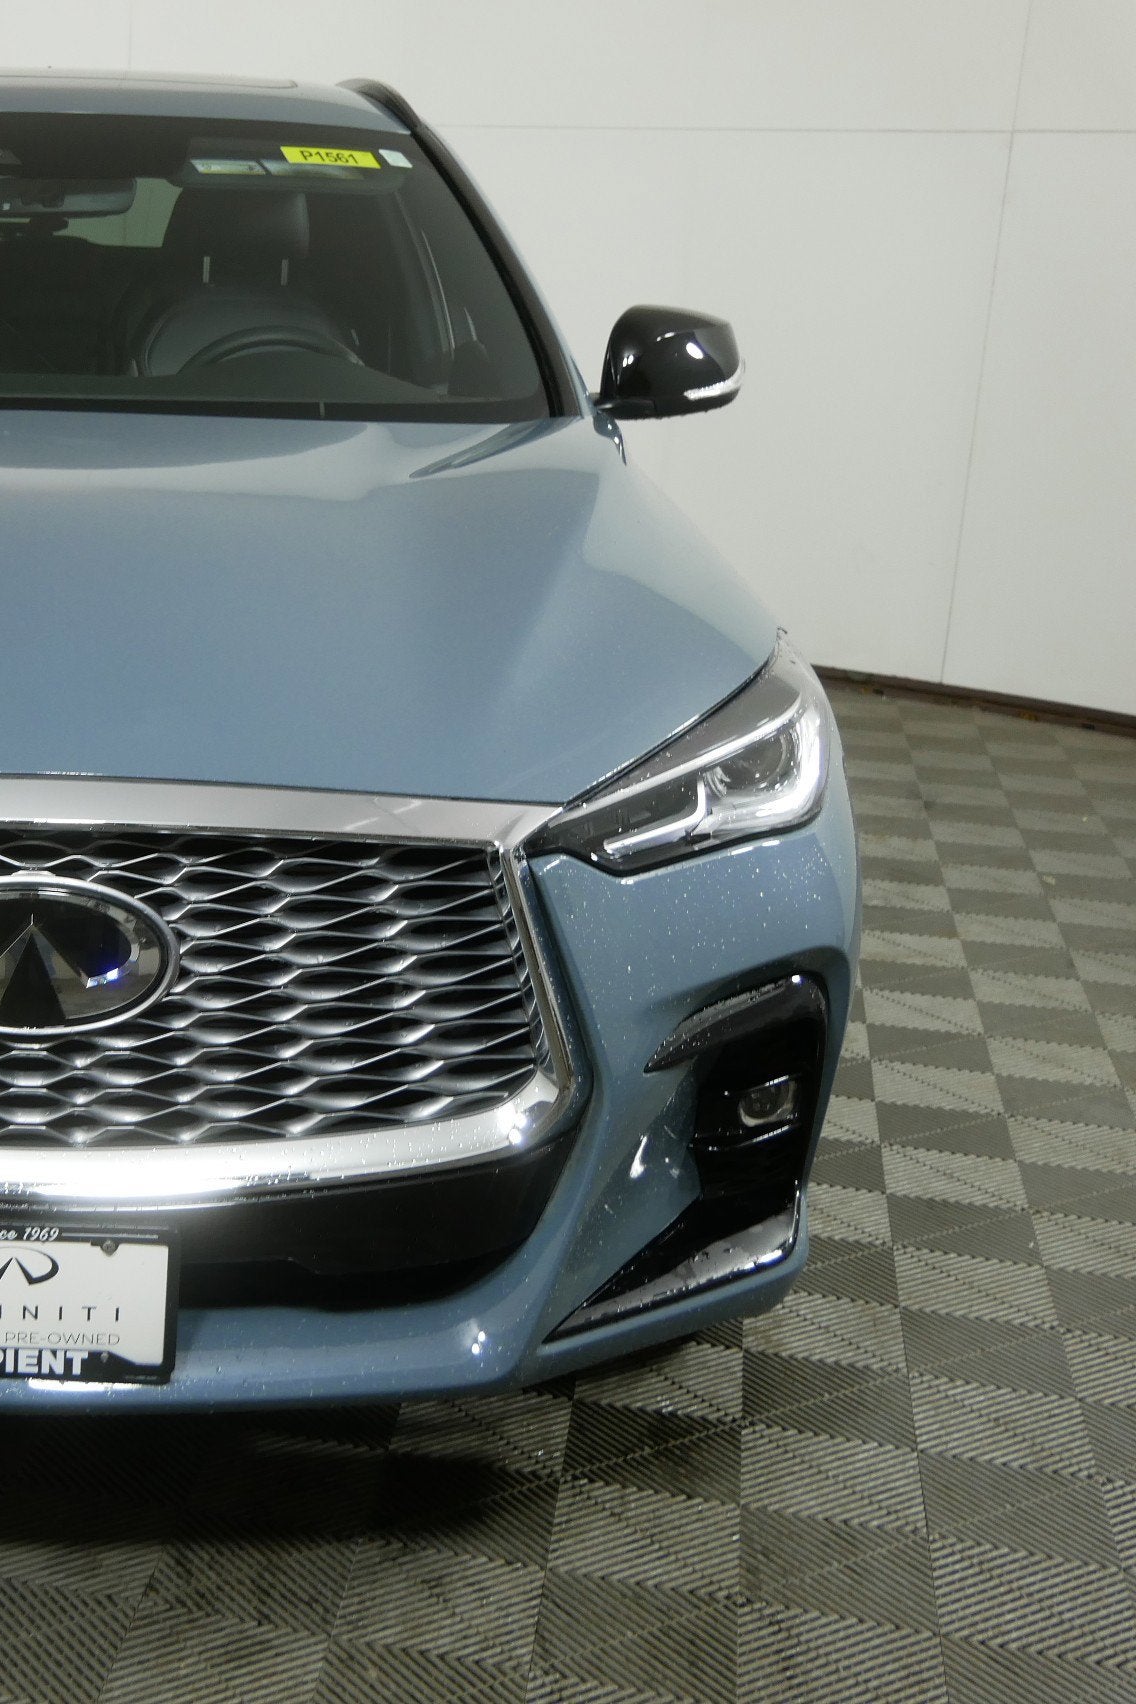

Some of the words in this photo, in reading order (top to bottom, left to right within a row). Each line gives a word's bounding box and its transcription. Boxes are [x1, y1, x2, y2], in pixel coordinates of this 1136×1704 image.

[300, 150, 358, 164] P1561
[22, 1225, 60, 1241] 1969
[5, 1331, 121, 1346] PRE-OWNED
